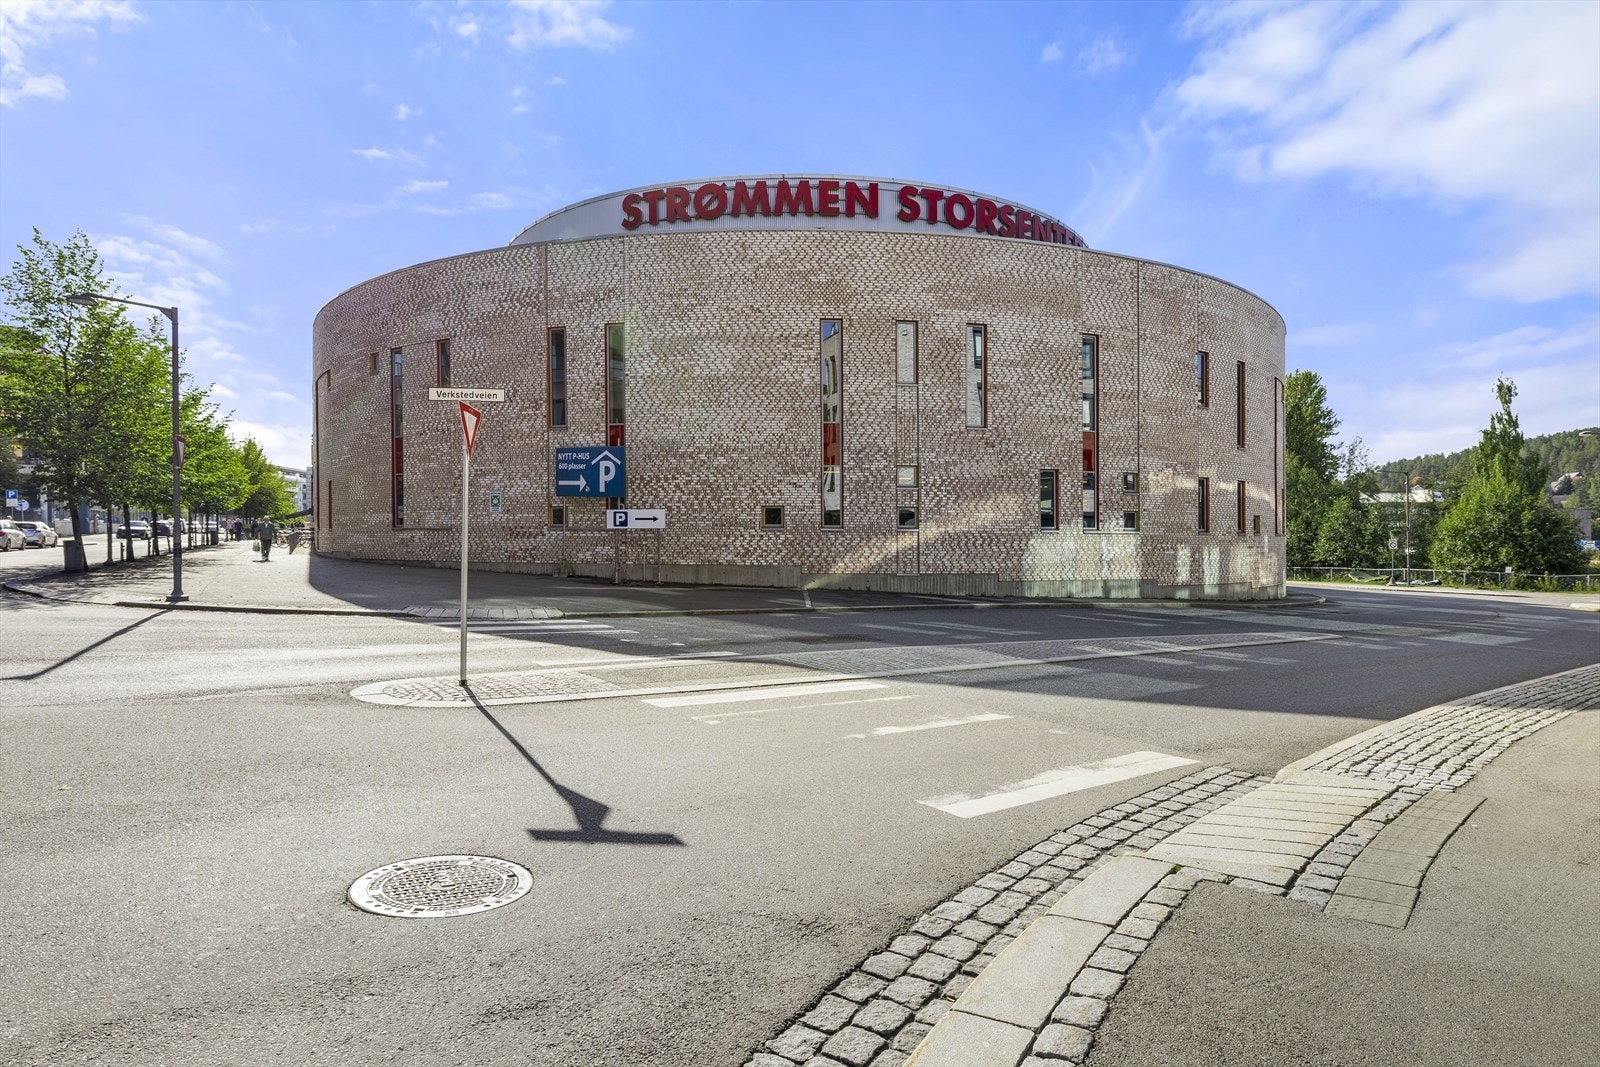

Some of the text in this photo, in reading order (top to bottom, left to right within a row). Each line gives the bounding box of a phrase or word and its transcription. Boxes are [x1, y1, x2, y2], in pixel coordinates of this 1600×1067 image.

[621, 180, 879, 228] STRØMMEN
[436, 390, 498, 399] Verkstedveien
[573, 452, 590, 460] P-HUS
[568, 463, 586, 471] plasser
[599, 460, 616, 493] P
[615, 513, 626, 526] P
